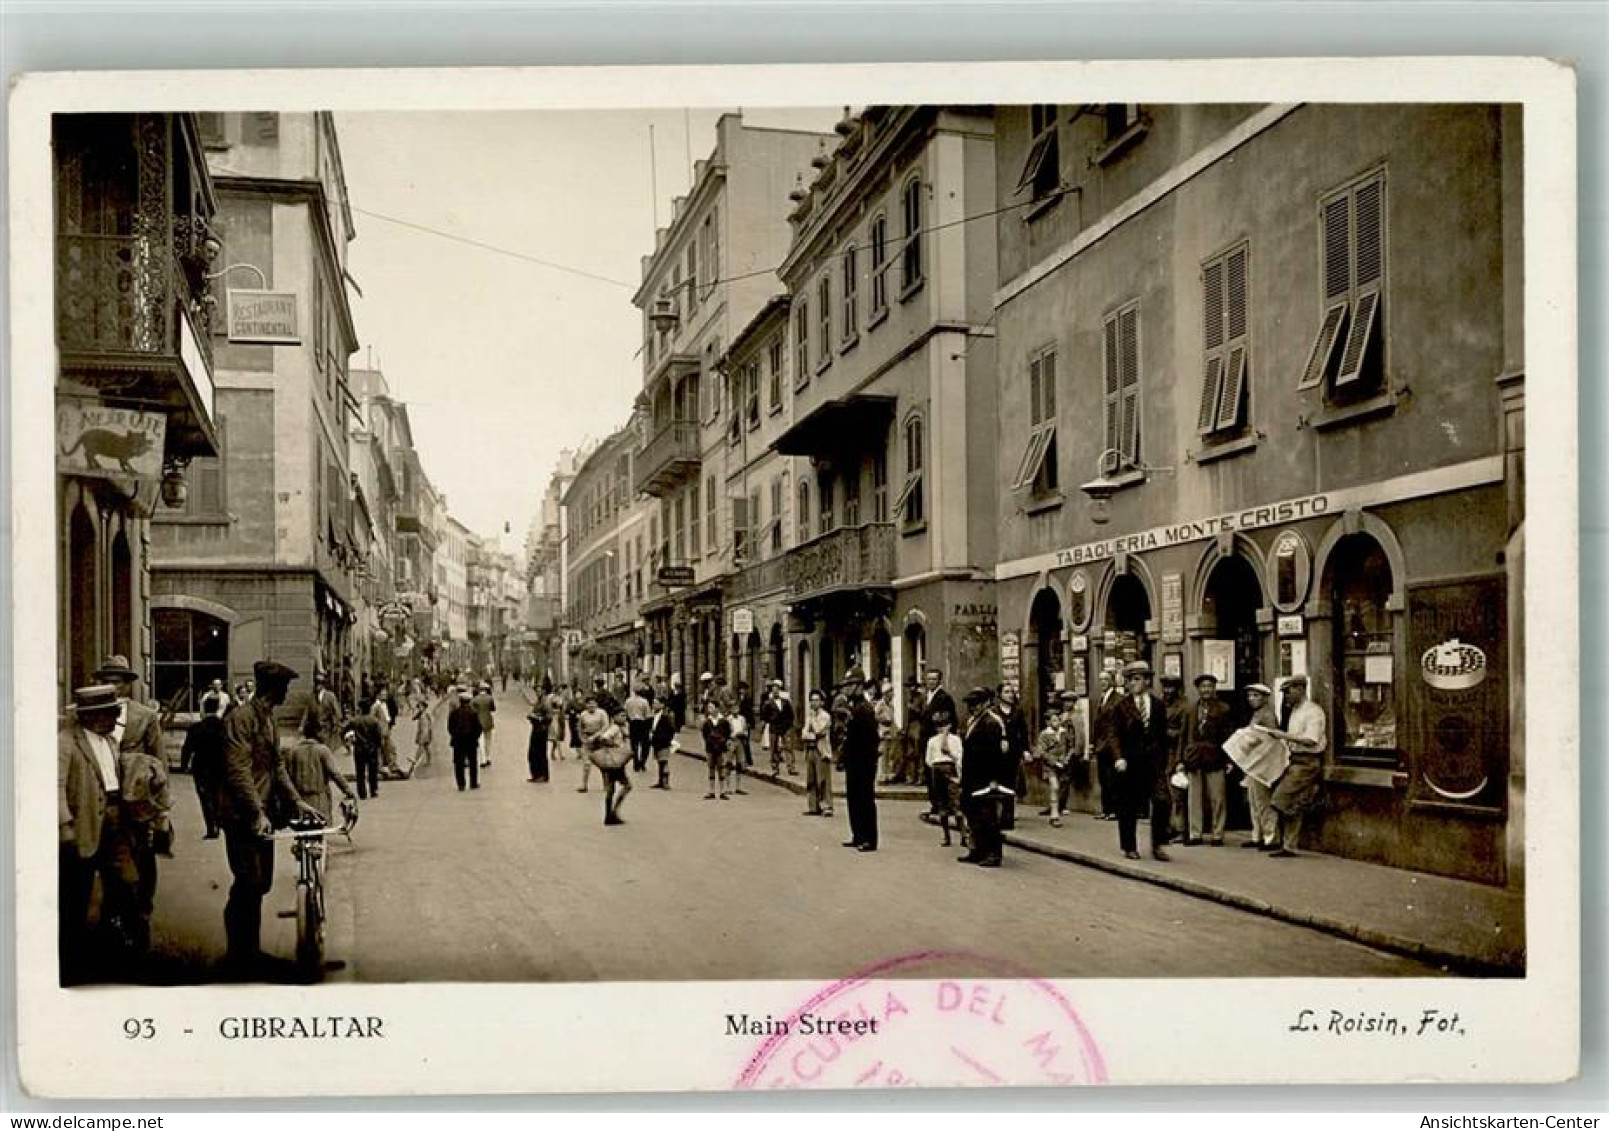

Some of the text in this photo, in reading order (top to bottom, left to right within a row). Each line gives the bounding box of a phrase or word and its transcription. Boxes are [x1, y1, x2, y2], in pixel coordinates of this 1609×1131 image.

[233, 321, 293, 337] CONTINENTAL
[1164, 515, 1235, 543] MONTE
[1239, 496, 1328, 528] CRISTO
[936, 981, 1006, 1026] DEL
